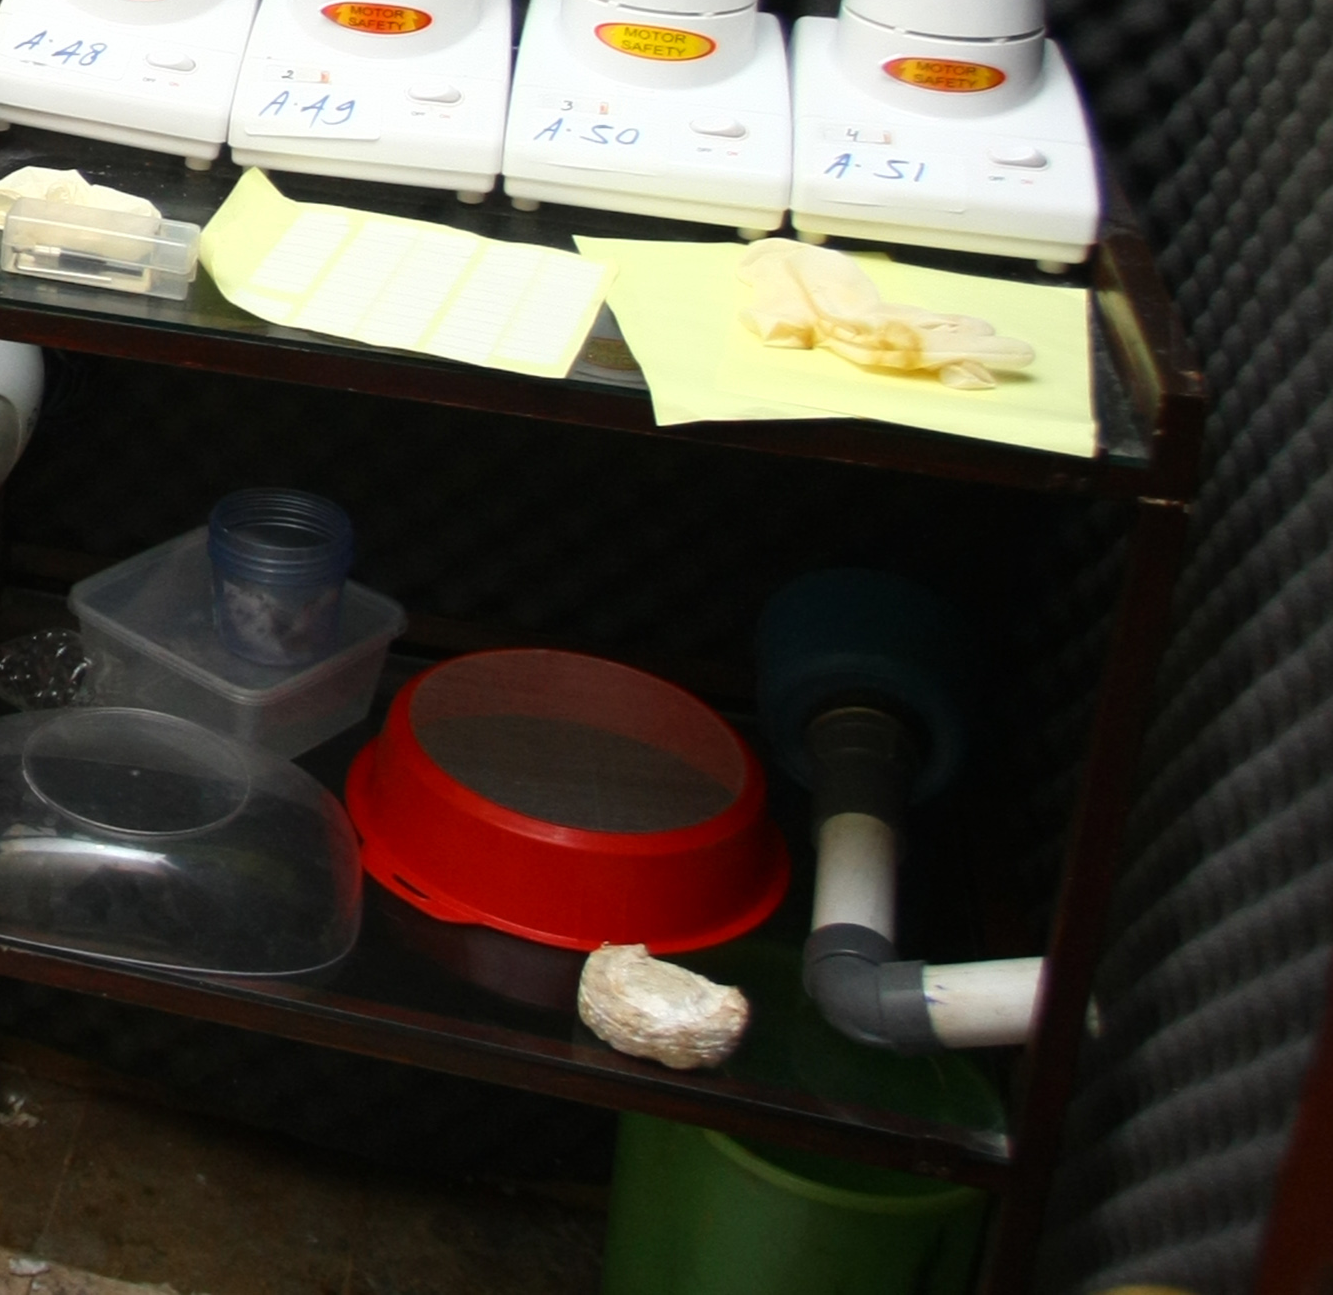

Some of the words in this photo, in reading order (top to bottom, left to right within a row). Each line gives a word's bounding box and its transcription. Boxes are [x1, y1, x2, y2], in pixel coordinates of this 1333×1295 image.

[350, 5, 404, 19] MOTOR
[348, 16, 406, 31] SAFETY
[623, 26, 687, 44] MOTOR
[621, 39, 687, 57] SAFETY
[916, 61, 977, 76] MOTOR
[914, 73, 979, 88] SAFETY
